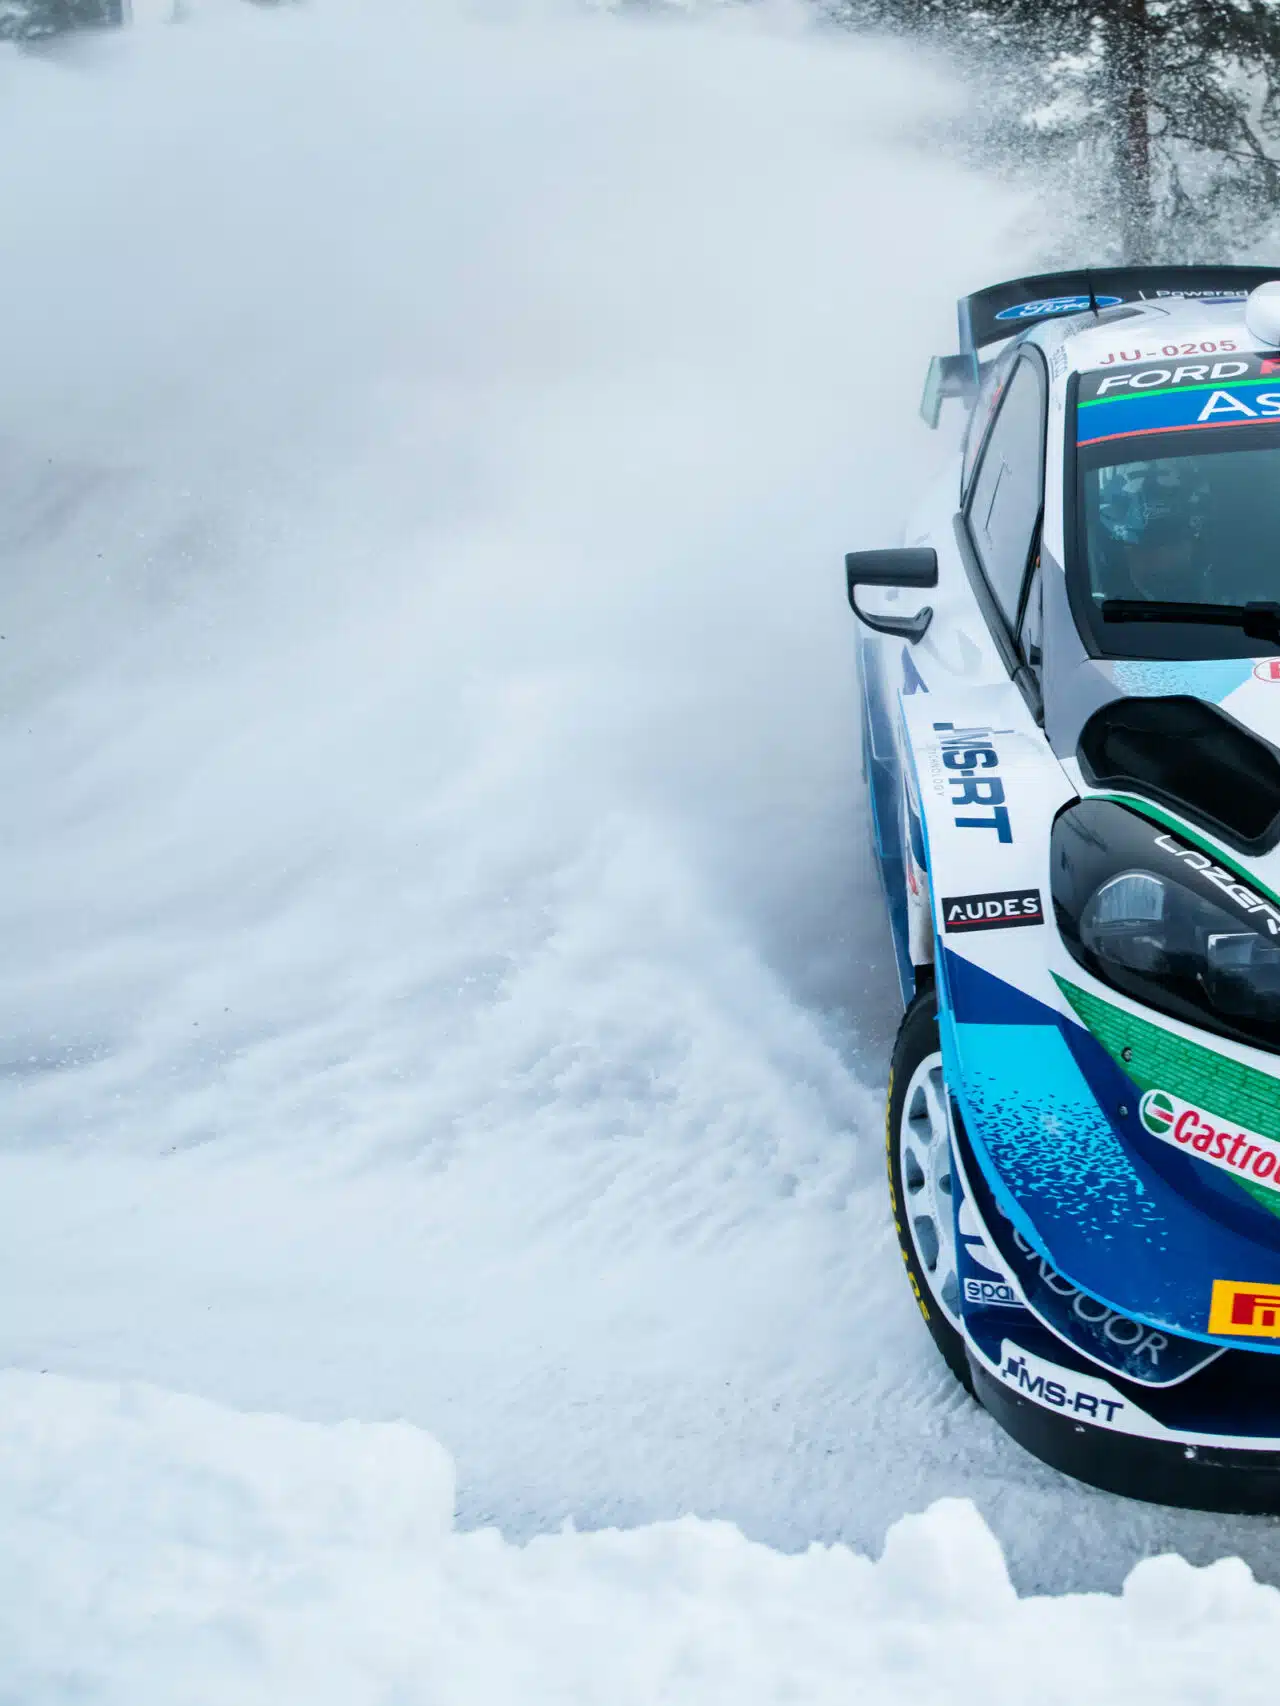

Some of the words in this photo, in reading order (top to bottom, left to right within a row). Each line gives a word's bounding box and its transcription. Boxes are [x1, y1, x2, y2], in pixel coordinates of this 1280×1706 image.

[1156, 289, 1249, 298] Powered
[1100, 340, 1237, 365] JU-0205
[1096, 361, 1249, 396] FORD
[937, 730, 1013, 844] MS-RT
[947, 897, 1039, 921] AUDES
[1019, 1366, 1125, 1422] MS-RT
